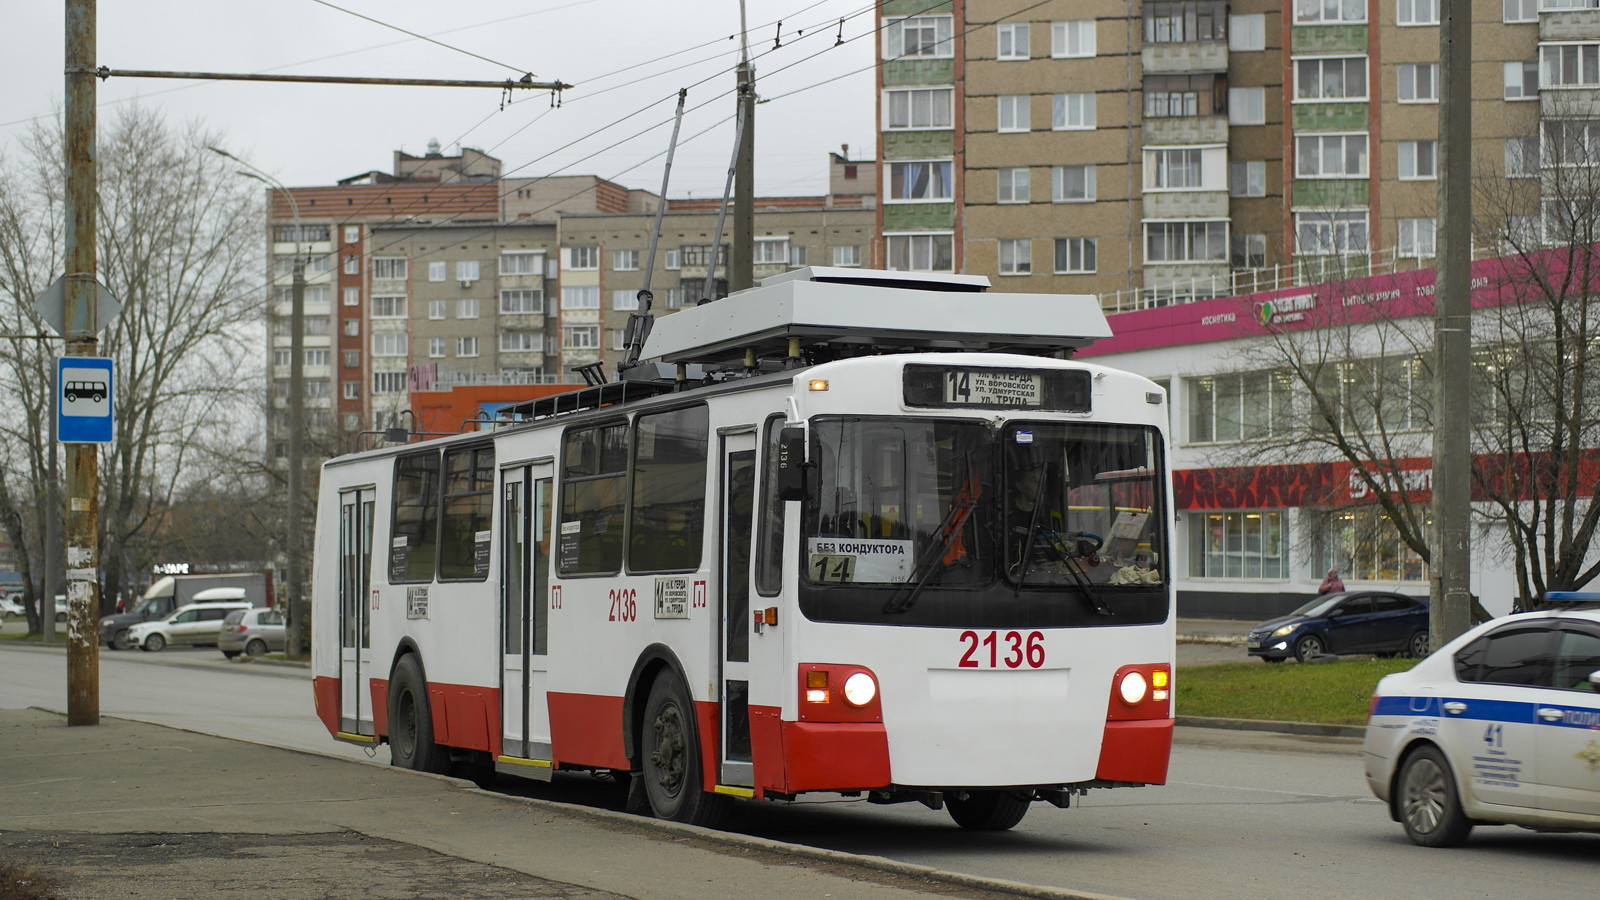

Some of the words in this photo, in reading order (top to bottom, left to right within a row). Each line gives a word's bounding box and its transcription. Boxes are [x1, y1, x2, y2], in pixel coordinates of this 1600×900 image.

[949, 371, 970, 402] 14
[988, 381, 1035, 391] ВОРОВСКОГО
[988, 387, 1035, 397] УДМУРТСКАЯ
[816, 543, 836, 553] БЕЗ
[839, 543, 905, 555] КОНДУКТОРА
[815, 556, 850, 582] 14
[608, 588, 637, 622] 2136
[656, 581, 664, 614] 14
[958, 630, 1045, 668] 2136
[1483, 724, 1503, 747] 41
